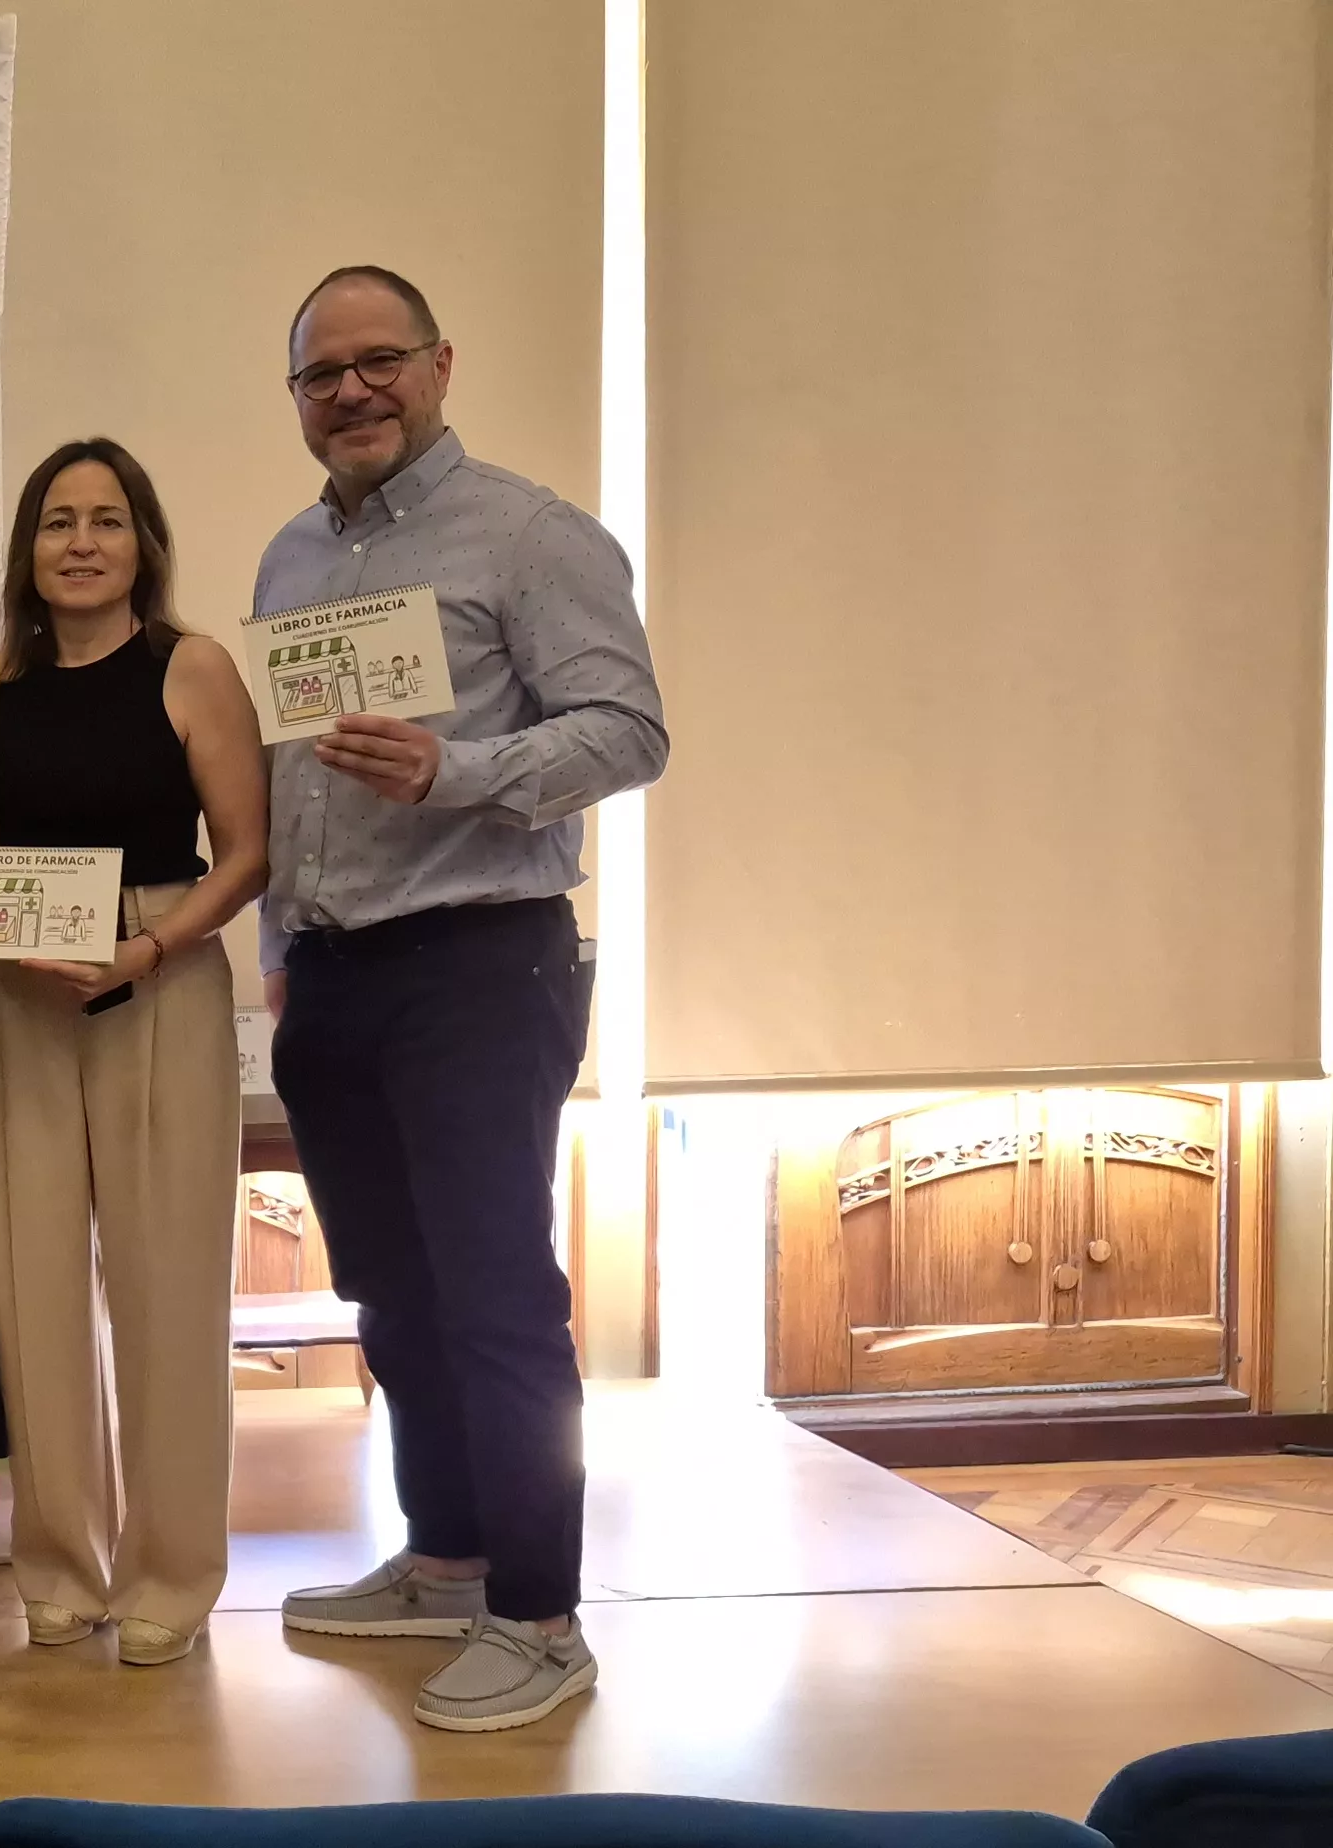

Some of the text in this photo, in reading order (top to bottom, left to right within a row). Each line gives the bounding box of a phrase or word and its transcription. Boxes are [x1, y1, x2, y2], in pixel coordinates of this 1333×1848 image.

[270, 598, 407, 635] LIBRO DE FARMACIA
[16, 855, 32, 865] DE
[35, 856, 96, 866] FARMACIA
